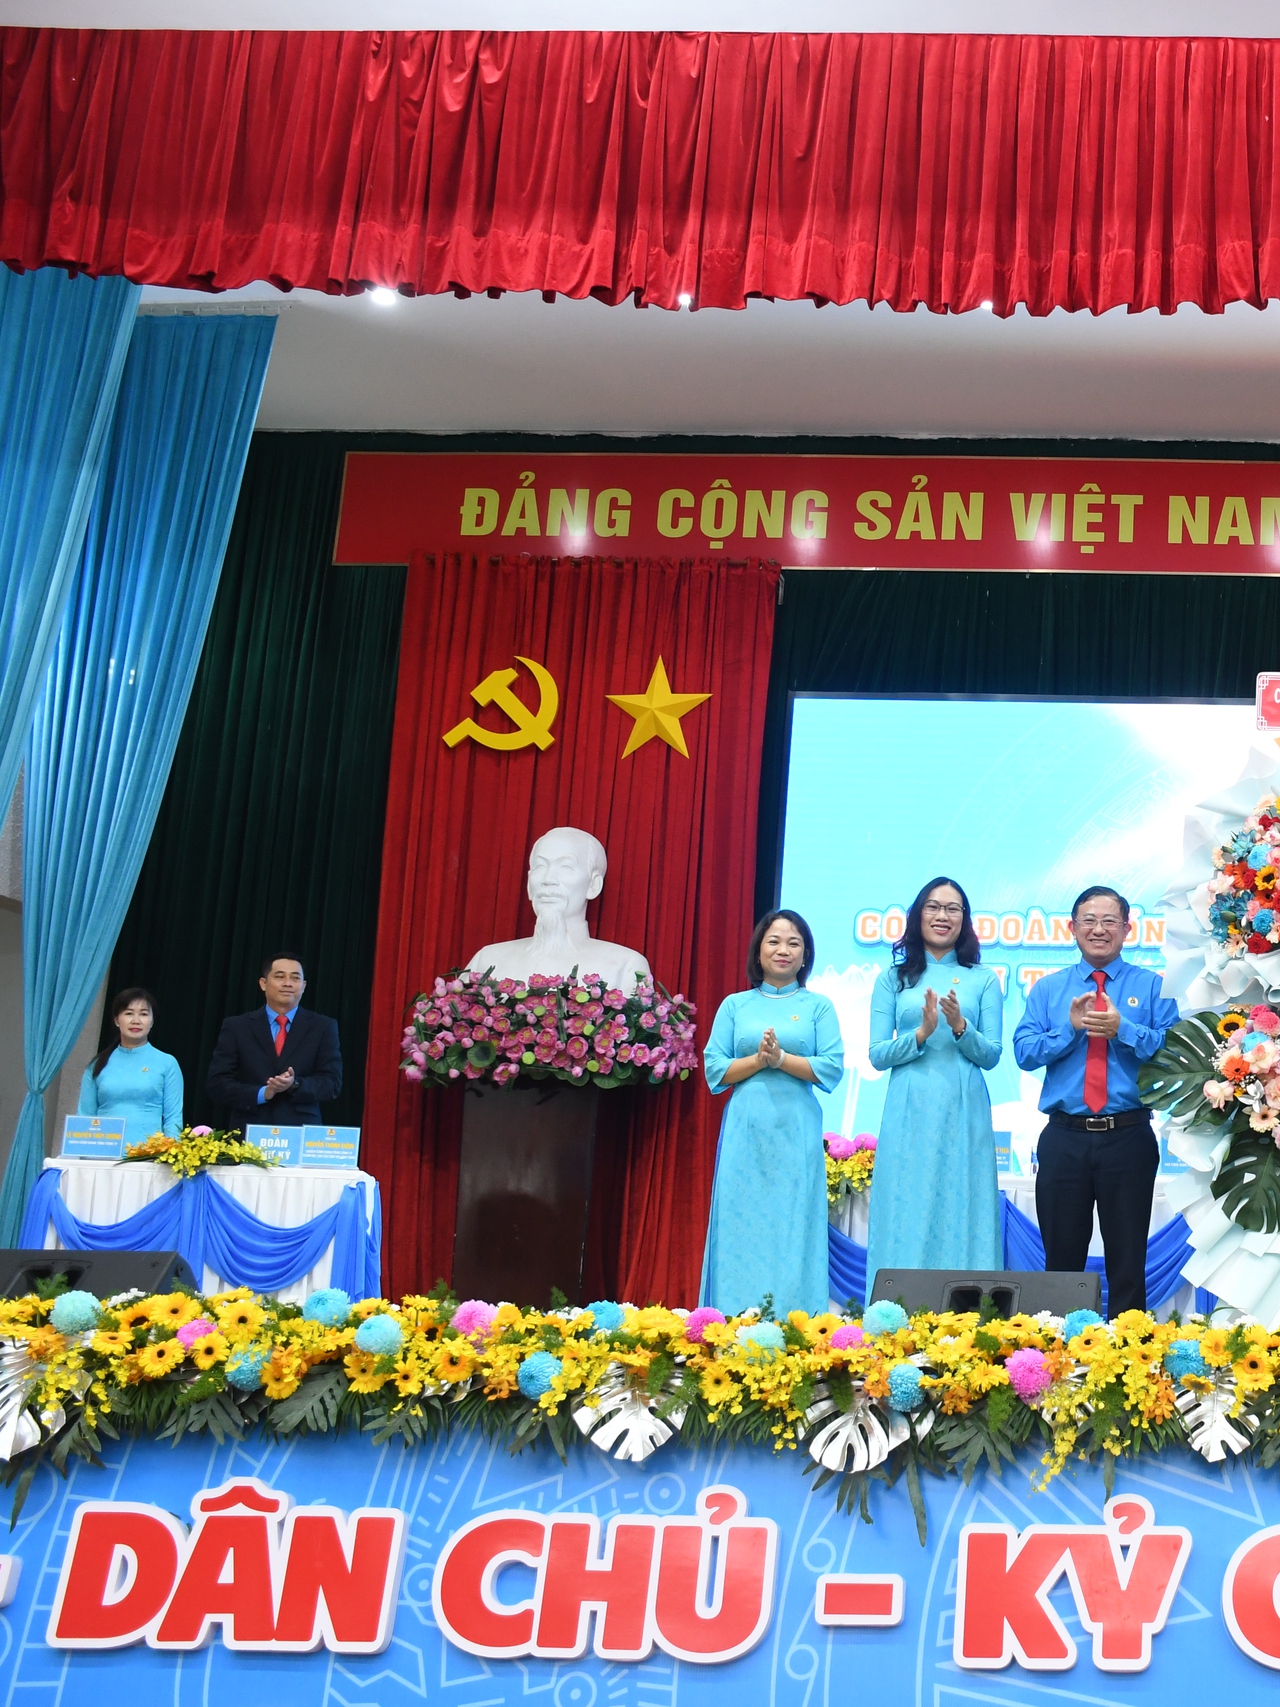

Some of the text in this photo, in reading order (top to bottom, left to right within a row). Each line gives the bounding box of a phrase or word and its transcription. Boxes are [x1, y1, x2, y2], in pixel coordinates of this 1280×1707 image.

[459, 470, 632, 539] ĐẢNG
[656, 478, 829, 550] CỘNG
[853, 473, 985, 542] SẢN
[1009, 482, 1145, 555] VIỆT
[861, 910, 904, 939] CÔ
[260, 1137, 289, 1148] ĐOÀN
[52, 1482, 398, 1645] DÂN
[438, 1489, 771, 1657] CHỦ
[959, 1499, 1184, 1662] KỶ
